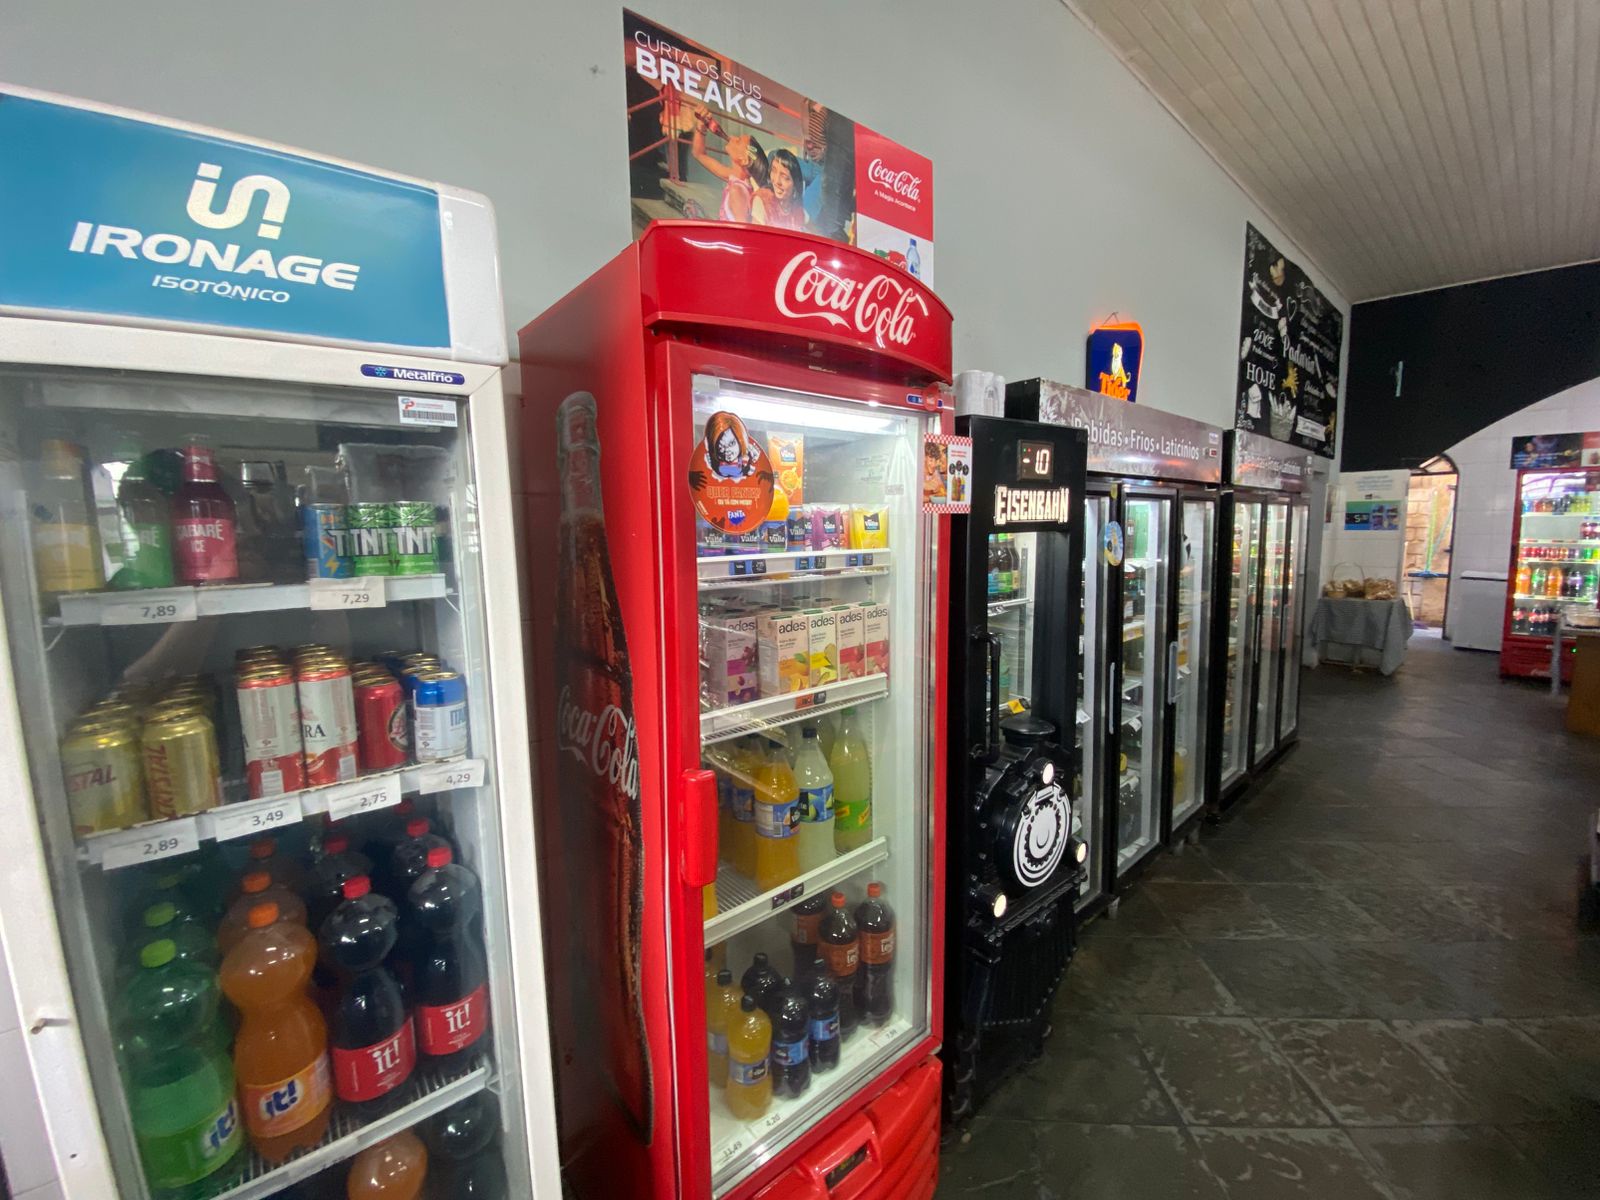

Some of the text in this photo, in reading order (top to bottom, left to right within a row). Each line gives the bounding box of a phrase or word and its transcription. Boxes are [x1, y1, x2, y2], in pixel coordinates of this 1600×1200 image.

[634, 30, 762, 101] CURTA OS SEUS
[635, 46, 763, 125] BREAKS
[69, 221, 361, 291] IRONAGE
[152, 274, 291, 304] ISOTÔNICO
[394, 368, 453, 384] Metalfrio
[1246, 361, 1276, 391] HOJE
[1130, 429, 1155, 453] Frios
[1161, 436, 1200, 460] Laticínios
[994, 484, 1069, 526] EISENBAHN
[350, 528, 391, 556] TNT
[392, 526, 435, 555] TNT
[342, 593, 370, 605] 7,29
[142, 604, 177, 620] 7,89
[810, 616, 835, 629] ades
[839, 611, 863, 625] ades
[866, 608, 888, 619] ades
[728, 620, 756, 634] ades
[778, 621, 807, 634] ades
[446, 772, 471, 785] 4,29
[359, 791, 387, 808] 2,75
[252, 809, 284, 827] 3,49
[143, 837, 178, 855] 2,89
[445, 1003, 471, 1033] it!
[372, 1039, 401, 1075] it!
[265, 1079, 298, 1118] it!
